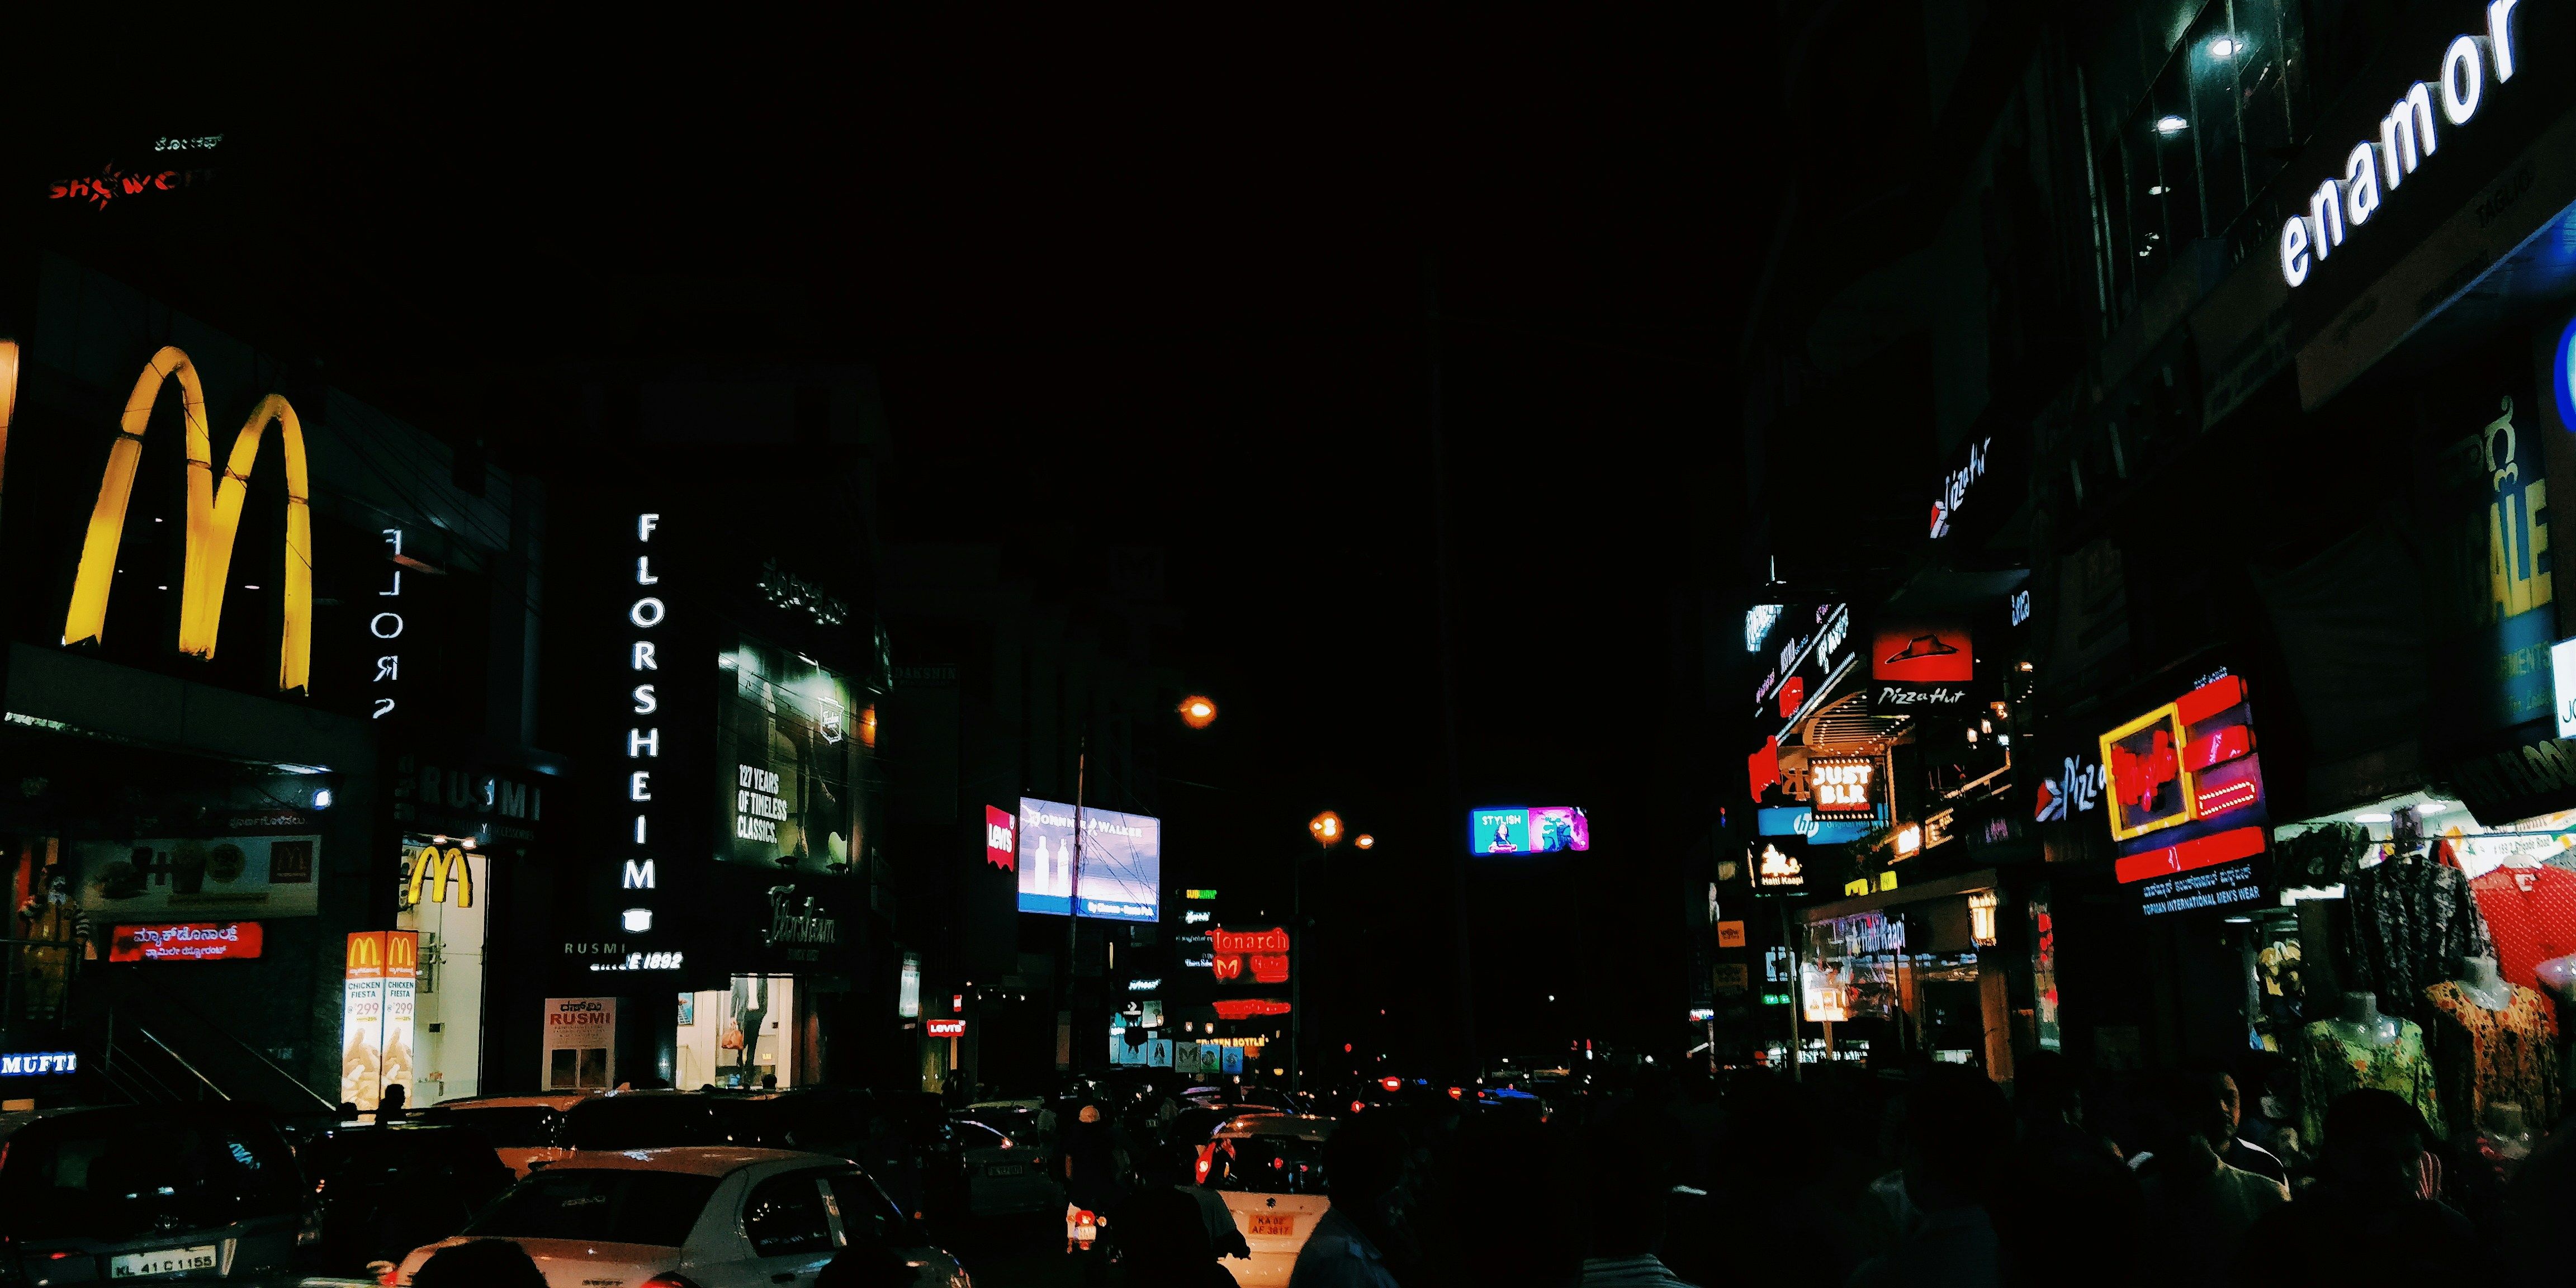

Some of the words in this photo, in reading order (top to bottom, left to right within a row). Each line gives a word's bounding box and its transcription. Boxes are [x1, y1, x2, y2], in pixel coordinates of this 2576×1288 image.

[2281, 0, 2520, 287] enamor
[622, 513, 665, 889] FLORSHEIM
[1877, 687, 1928, 704] Pizza
[1929, 688, 1966, 704] Hut
[739, 764, 753, 788] 127
[754, 768, 779, 795] YEARS
[1812, 765, 1872, 786] JUST
[1820, 783, 1868, 804] BLR
[738, 789, 750, 813] OF
[750, 792, 787, 822] TIMELESS
[737, 815, 778, 844] CLASSICS.
[1099, 820, 1143, 838] WALKER
[1482, 815, 1521, 826] STYLISH
[2166, 893, 2217, 913] INTERNATIONAL
[2216, 889, 2238, 905] MEN'S
[2237, 886, 2261, 901] WEAR
[564, 943, 626, 954] RUSMI
[643, 951, 684, 970] 1892
[348, 982, 380, 990] CHICKEN
[550, 1012, 612, 1025] RUSMI
[1, 1053, 76, 1076] MUFTI
[116, 1265, 136, 1276] KL
[141, 1262, 158, 1274] 41
[178, 1256, 212, 1270] 1155
